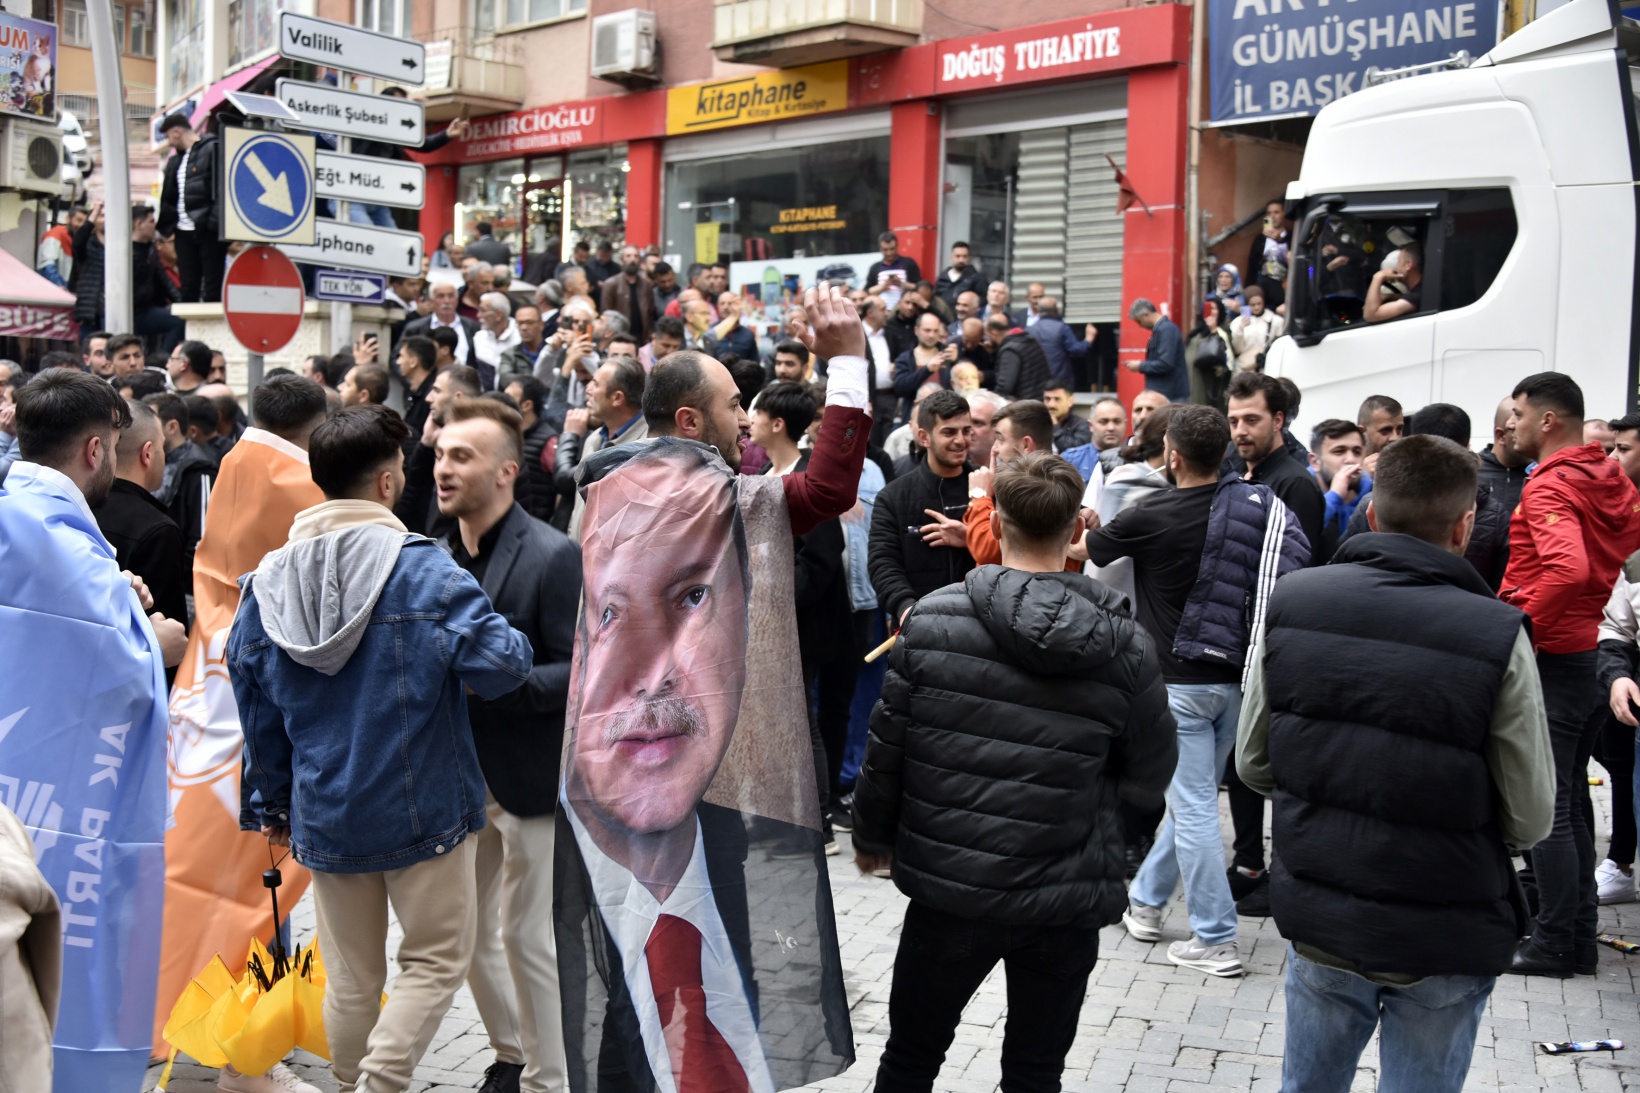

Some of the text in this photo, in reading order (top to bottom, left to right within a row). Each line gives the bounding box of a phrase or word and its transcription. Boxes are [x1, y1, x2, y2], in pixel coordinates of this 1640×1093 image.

[288, 27, 343, 55] Valilik
[1232, 3, 1477, 67] GÜMÜŞHANE
[942, 23, 1120, 82] DOĞUŞ TUHAFİYE
[287, 98, 388, 125] Askerlik Şubesi
[697, 80, 807, 116] kitaphane
[1233, 79, 1261, 114] İL
[316, 167, 385, 189] Eğt. Müd.
[323, 276, 363, 294] TEK YÖN
